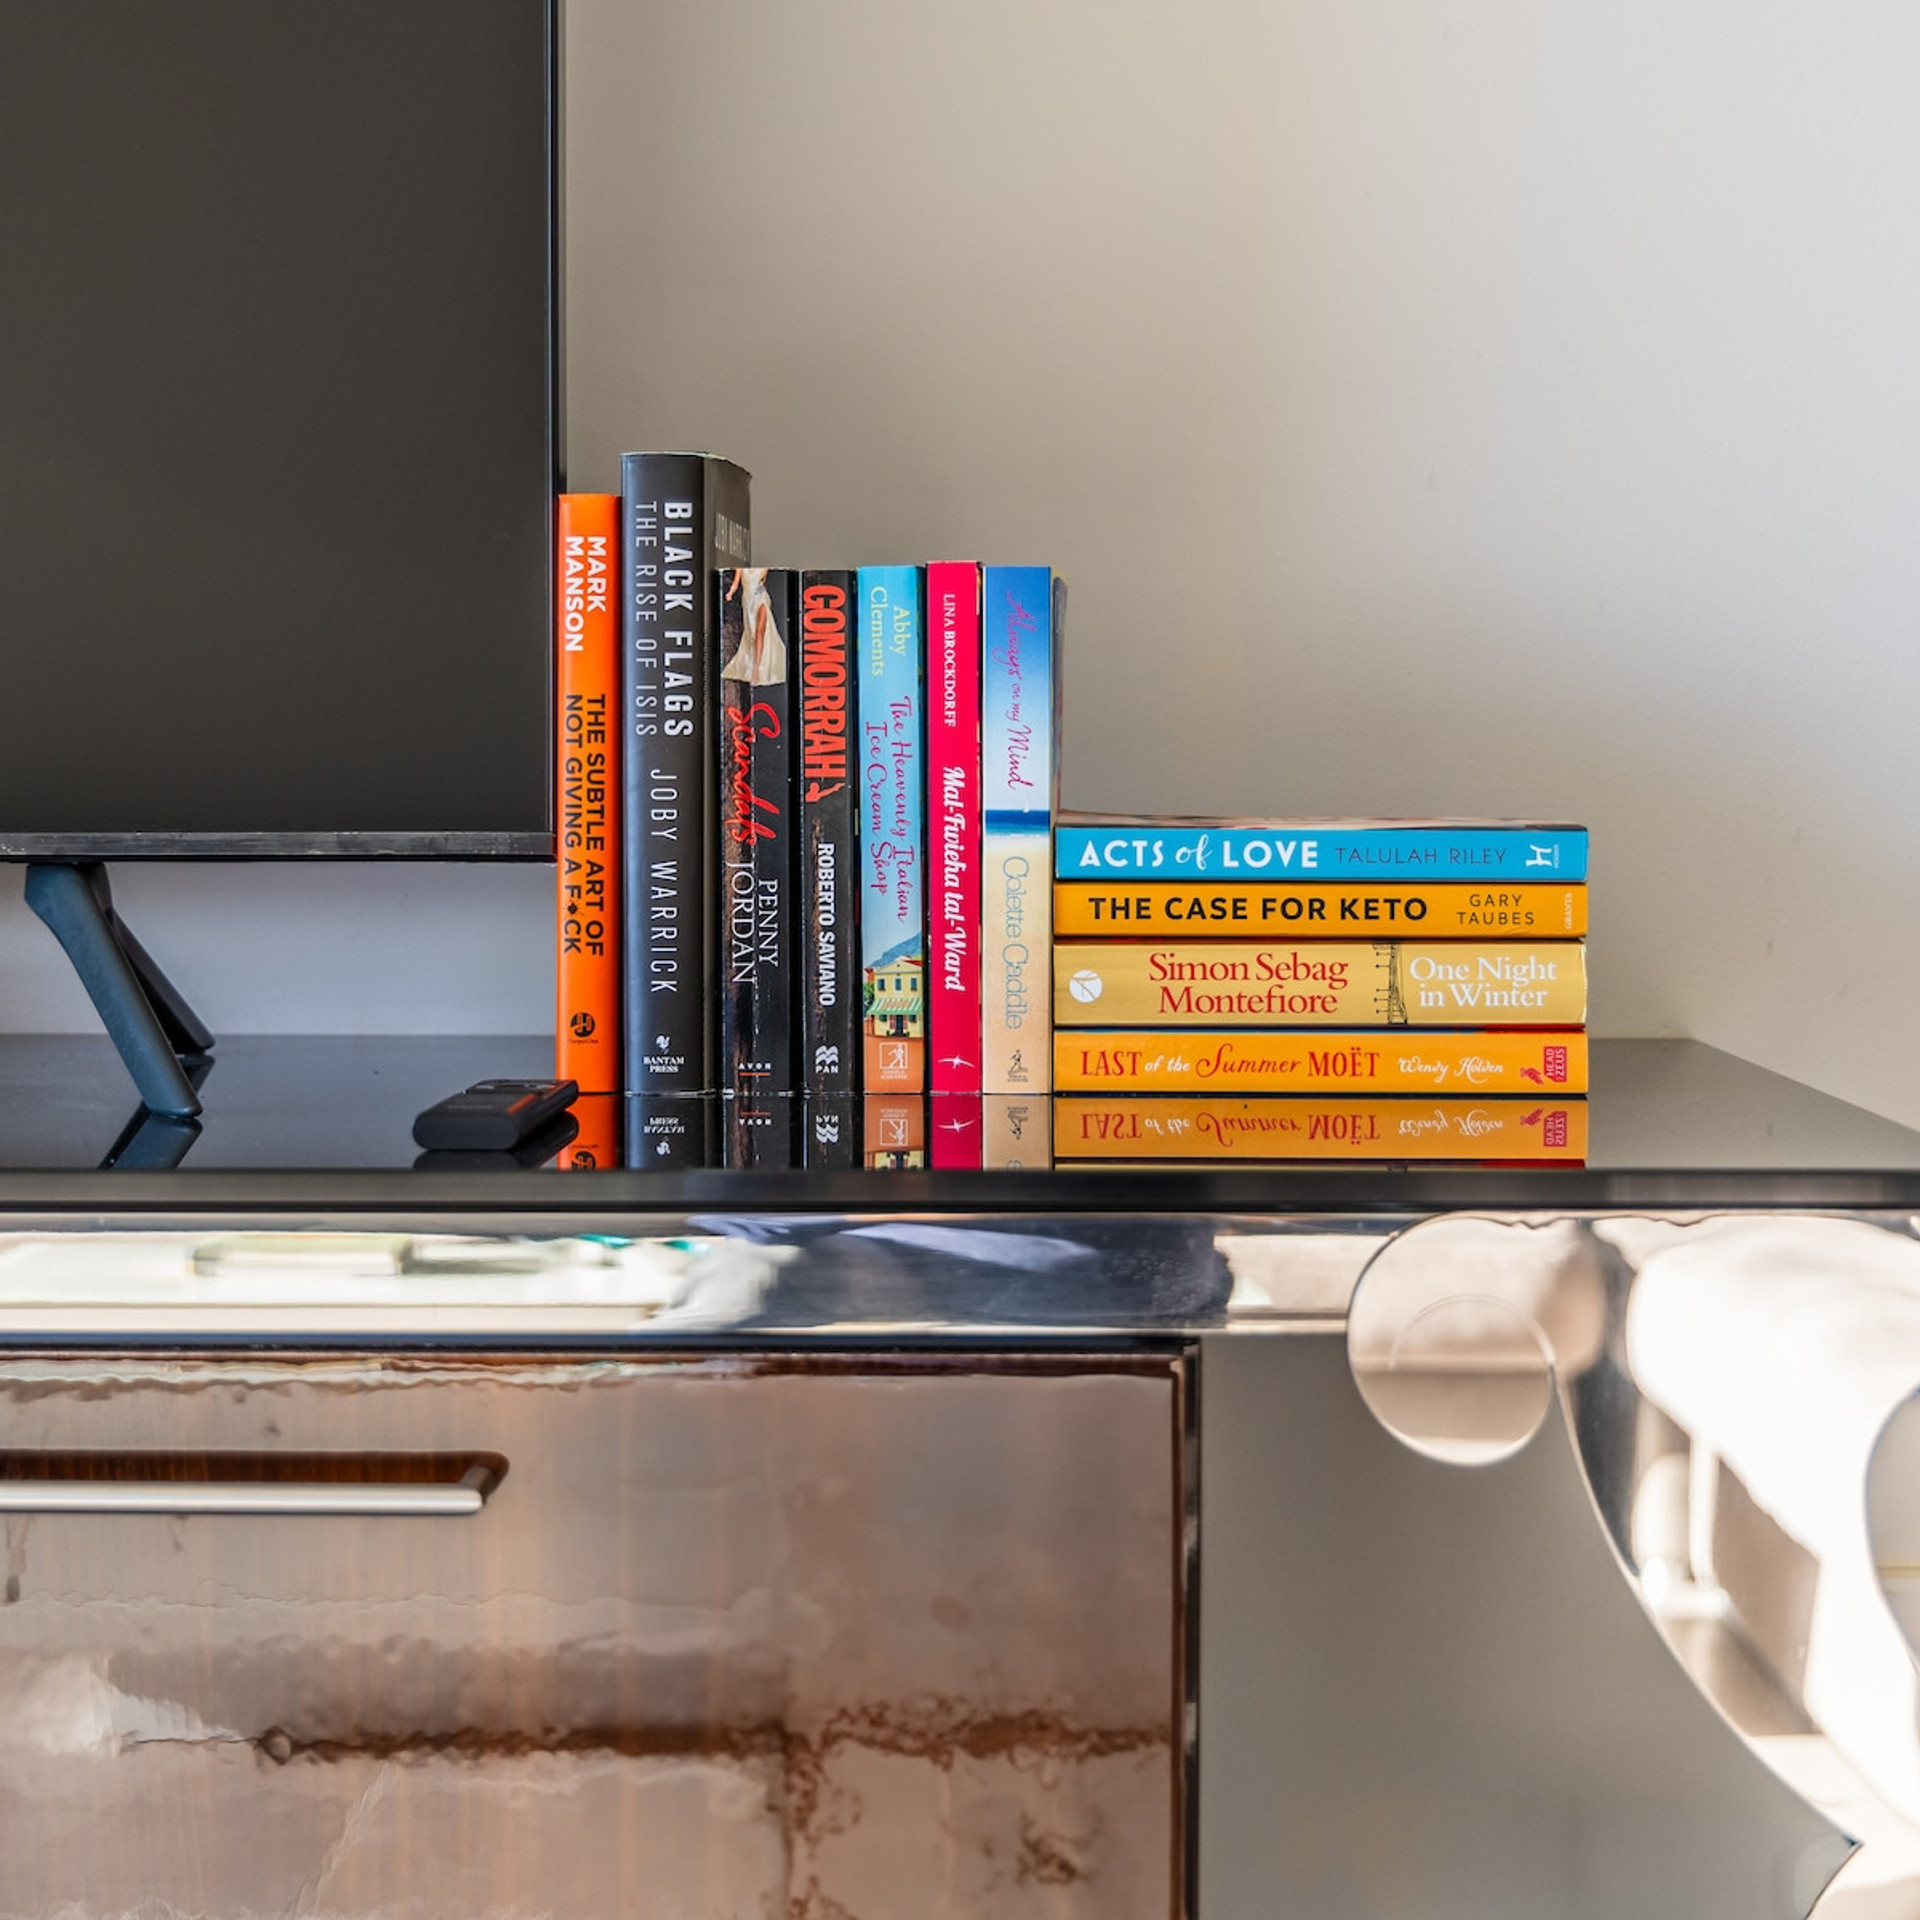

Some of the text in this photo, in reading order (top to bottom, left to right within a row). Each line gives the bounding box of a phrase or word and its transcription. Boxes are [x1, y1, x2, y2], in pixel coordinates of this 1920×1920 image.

[565, 536, 584, 651] MANSON
[587, 536, 607, 613] MARK
[635, 501, 657, 736] THE RISE OF ISIS
[664, 501, 693, 736] BLACK FLAGS
[870, 586, 888, 677] Clements
[889, 605, 912, 656] Abby
[803, 585, 846, 779] GOMORRAH
[943, 593, 957, 727] LINA BROCKDORFF
[992, 590, 1038, 790] Always on my Mind
[565, 694, 583, 748] NOT
[724, 702, 781, 846] Scandals
[564, 756, 583, 849] GIVING
[585, 693, 606, 957] THE SUBTLE ART OF
[866, 721, 893, 896] Ice Cream Shop
[889, 695, 915, 922] The Heavenly Italian
[564, 857, 582, 875] A
[1079, 833, 1319, 871] ACTS of LOVE
[1335, 848, 1507, 864] TALULAH RILEY
[649, 768, 677, 993] JOBY WARRICK
[1469, 893, 1523, 907] GARY
[725, 862, 756, 985] JORDAN
[757, 878, 778, 968] PENNY
[817, 843, 837, 1007] ROBERTO SAVIANO
[1088, 897, 1428, 921] THE CASE FOR KETO
[1457, 911, 1535, 925] TAUBES
[943, 892, 968, 992] tal-Ward
[1002, 855, 1030, 1031] Colette Caddle
[1149, 951, 1349, 990] Simon Sebag
[1409, 955, 1558, 987] One Night
[1420, 982, 1548, 1008] in Winter
[1159, 984, 1338, 1014] Montefiore
[643, 1056, 685, 1065] BANTAM
[649, 1065, 680, 1073] PRESS
[739, 1062, 772, 1070] AVON
[815, 1065, 838, 1073] PAN
[1081, 1043, 1381, 1078] LAST of the Summer MOËT
[1398, 1055, 1504, 1085] Wendy Holden
[1546, 1048, 1555, 1077] HEAD
[1555, 1048, 1565, 1077] ZEUS
